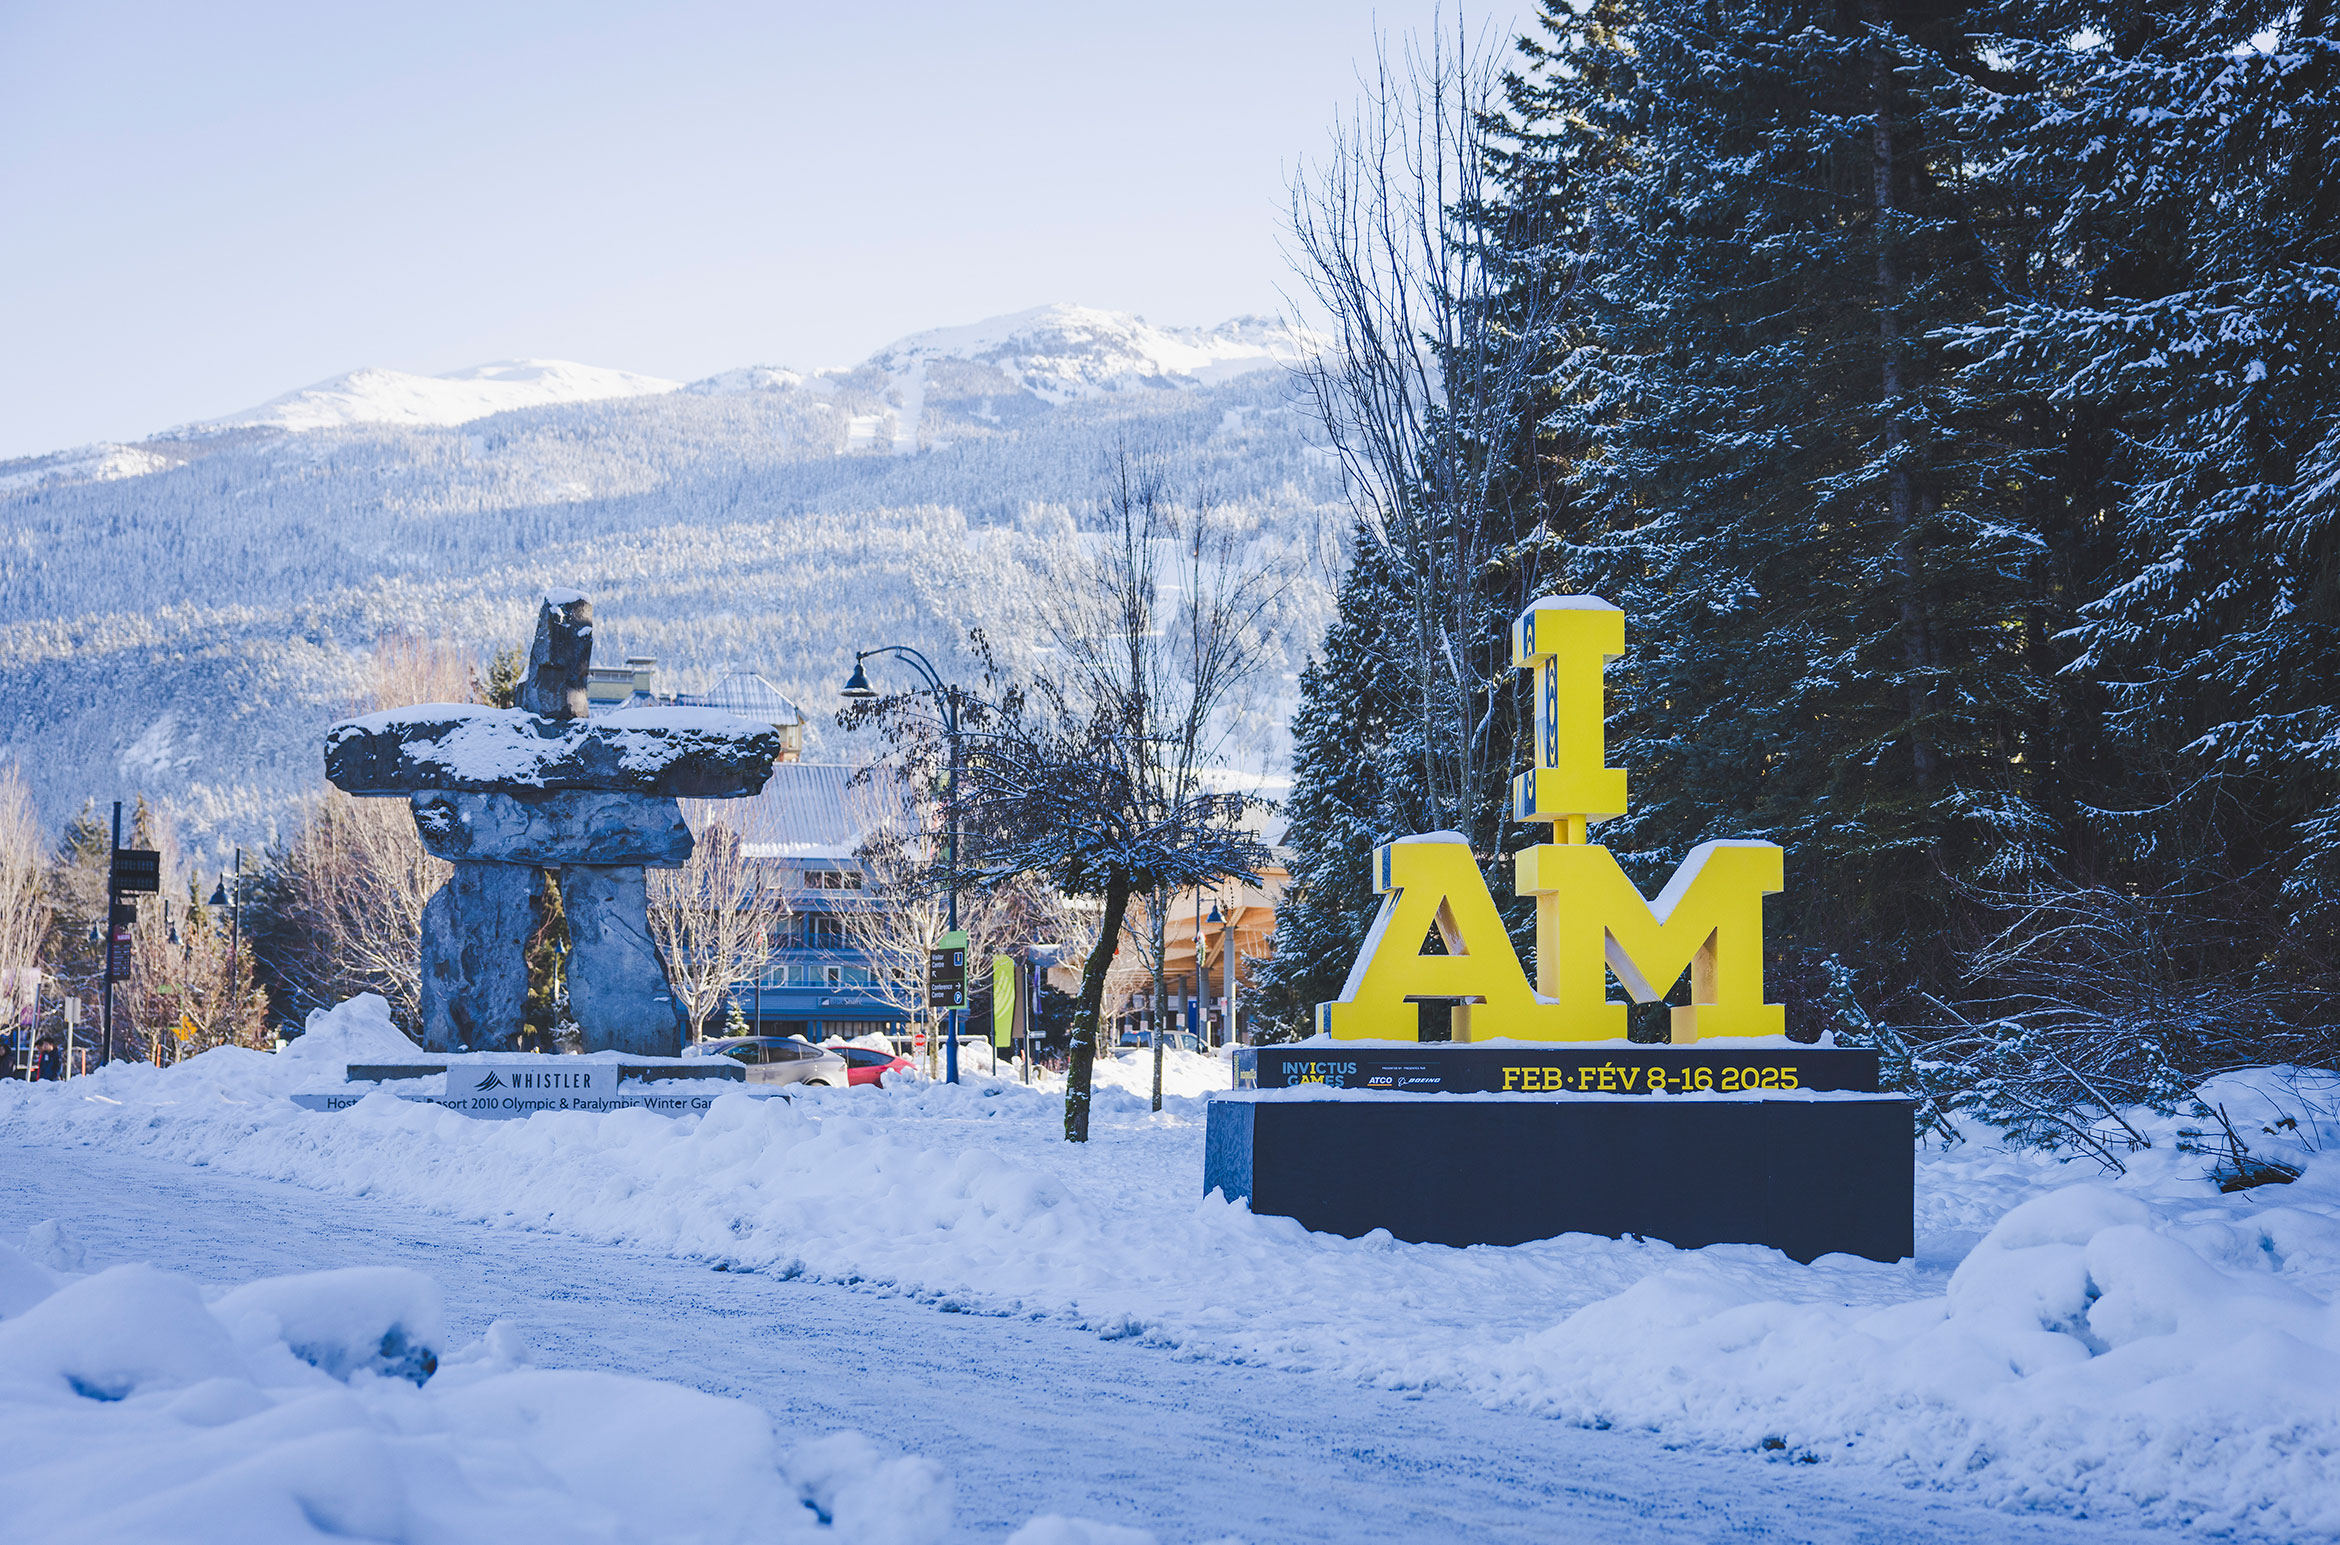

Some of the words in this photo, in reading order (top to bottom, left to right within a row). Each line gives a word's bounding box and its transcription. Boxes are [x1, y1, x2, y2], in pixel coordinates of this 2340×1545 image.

[1513, 608, 1628, 823] I
[1318, 842, 1786, 1043] AM
[1282, 1061, 1357, 1075] INVICTUS
[512, 1073, 591, 1088] WHISTLER
[1287, 1074, 1345, 1087] GAMES
[1368, 1076, 1393, 1084] ATCO
[1646, 1067, 1713, 1090] 8-16
[1721, 1067, 1798, 1090] 2025
[327, 1097, 357, 1109] Host
[427, 1097, 468, 1110] sort
[471, 1098, 499, 1110] 2010
[502, 1097, 555, 1112] Olympic
[560, 1098, 569, 1109] &
[573, 1097, 640, 1112] Paralympic
[644, 1097, 688, 1109] Winter
